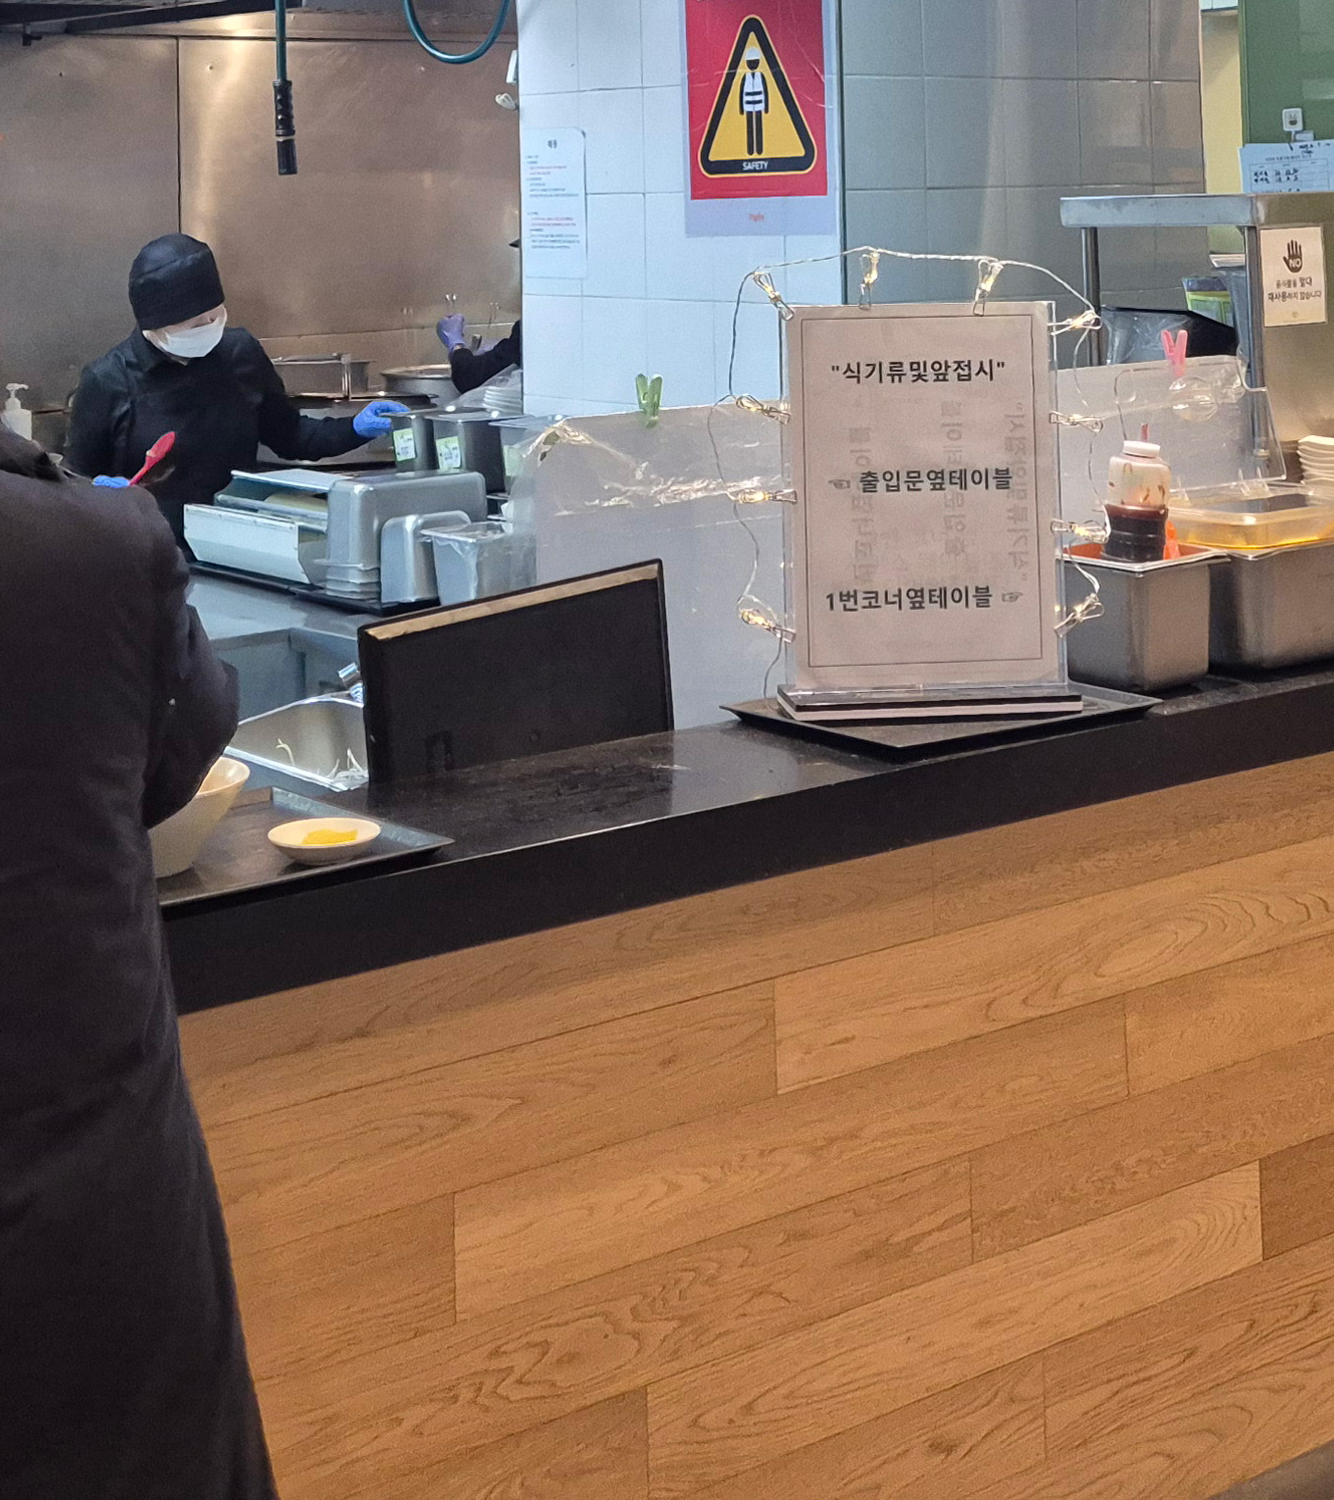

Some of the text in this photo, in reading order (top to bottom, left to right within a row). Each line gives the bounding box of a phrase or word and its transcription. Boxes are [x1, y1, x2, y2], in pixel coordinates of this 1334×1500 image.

[742, 161, 768, 171] SAFETY
[1289, 258, 1302, 269] NO
[831, 358, 1006, 385] "식기류및앞접시"
[859, 466, 1014, 493] 출입문옆테이블
[825, 584, 994, 613] 1번코너옆테이블
